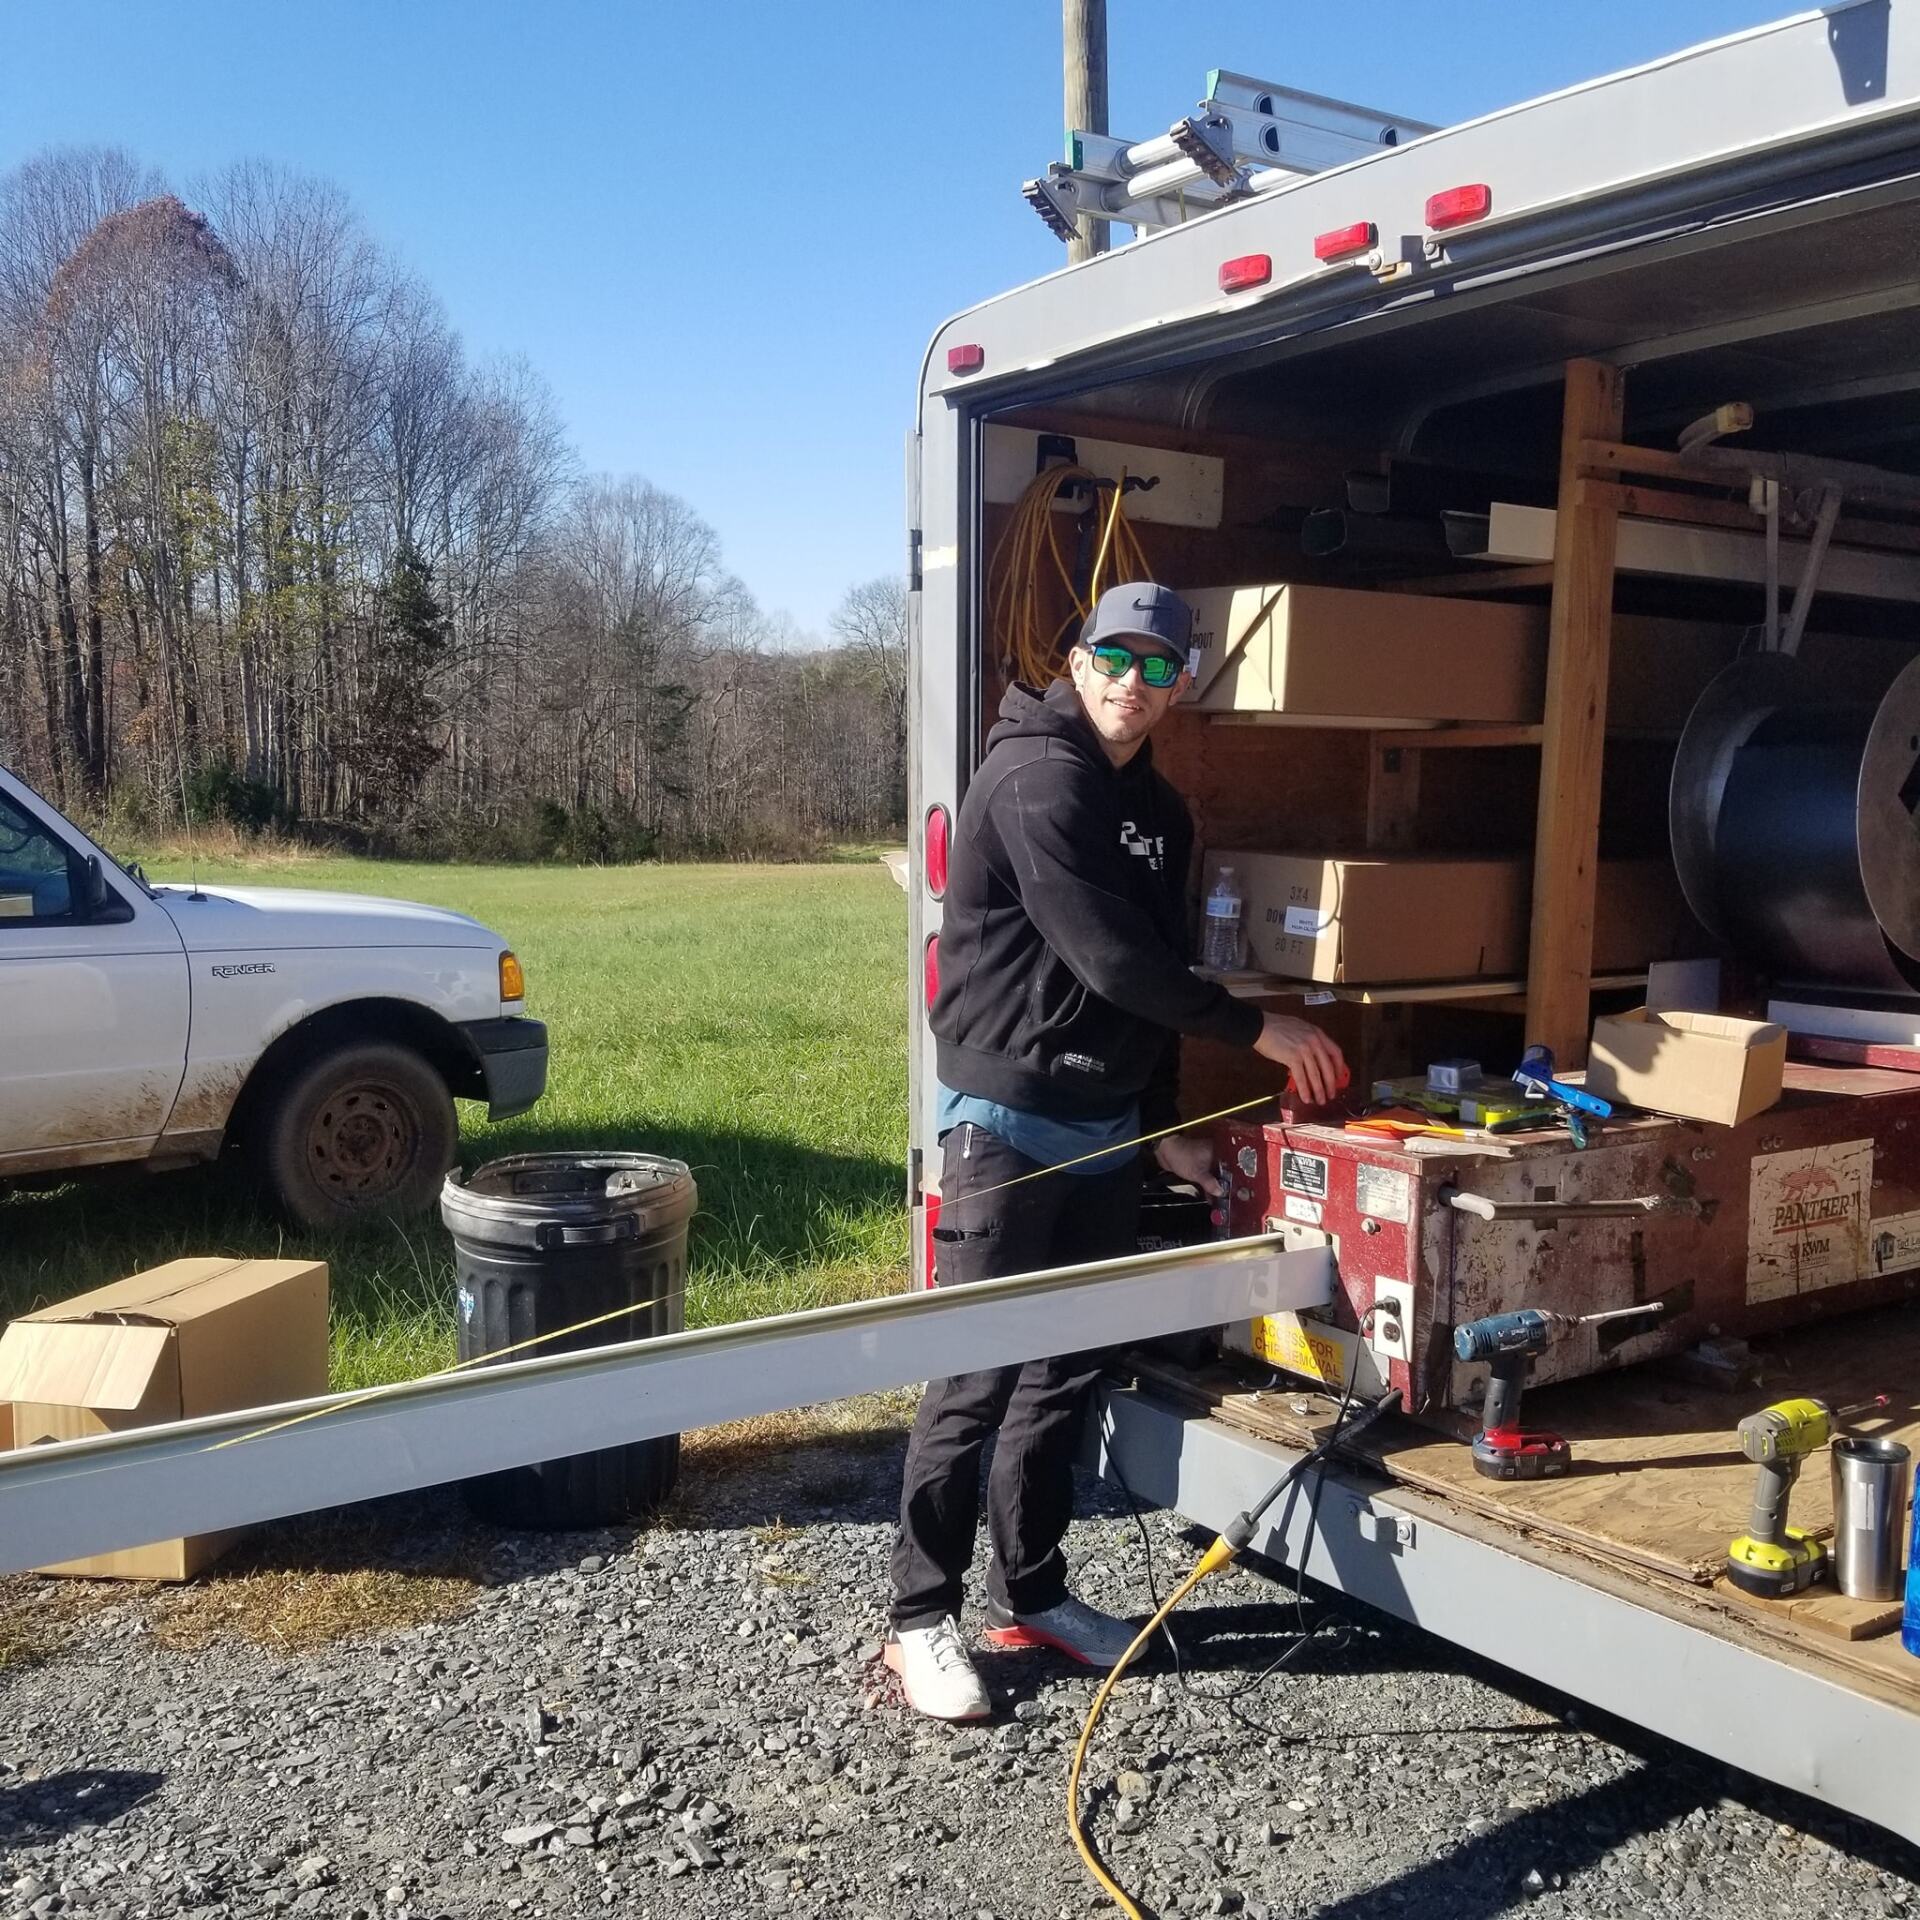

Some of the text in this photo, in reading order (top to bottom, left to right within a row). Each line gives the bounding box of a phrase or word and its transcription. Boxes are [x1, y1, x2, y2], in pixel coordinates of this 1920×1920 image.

[212, 963, 276, 978] RANGER
[1773, 1194, 1850, 1228] PANTHER
[1802, 1238, 1831, 1258] KWM
[1309, 1338, 1334, 1358] FOR
